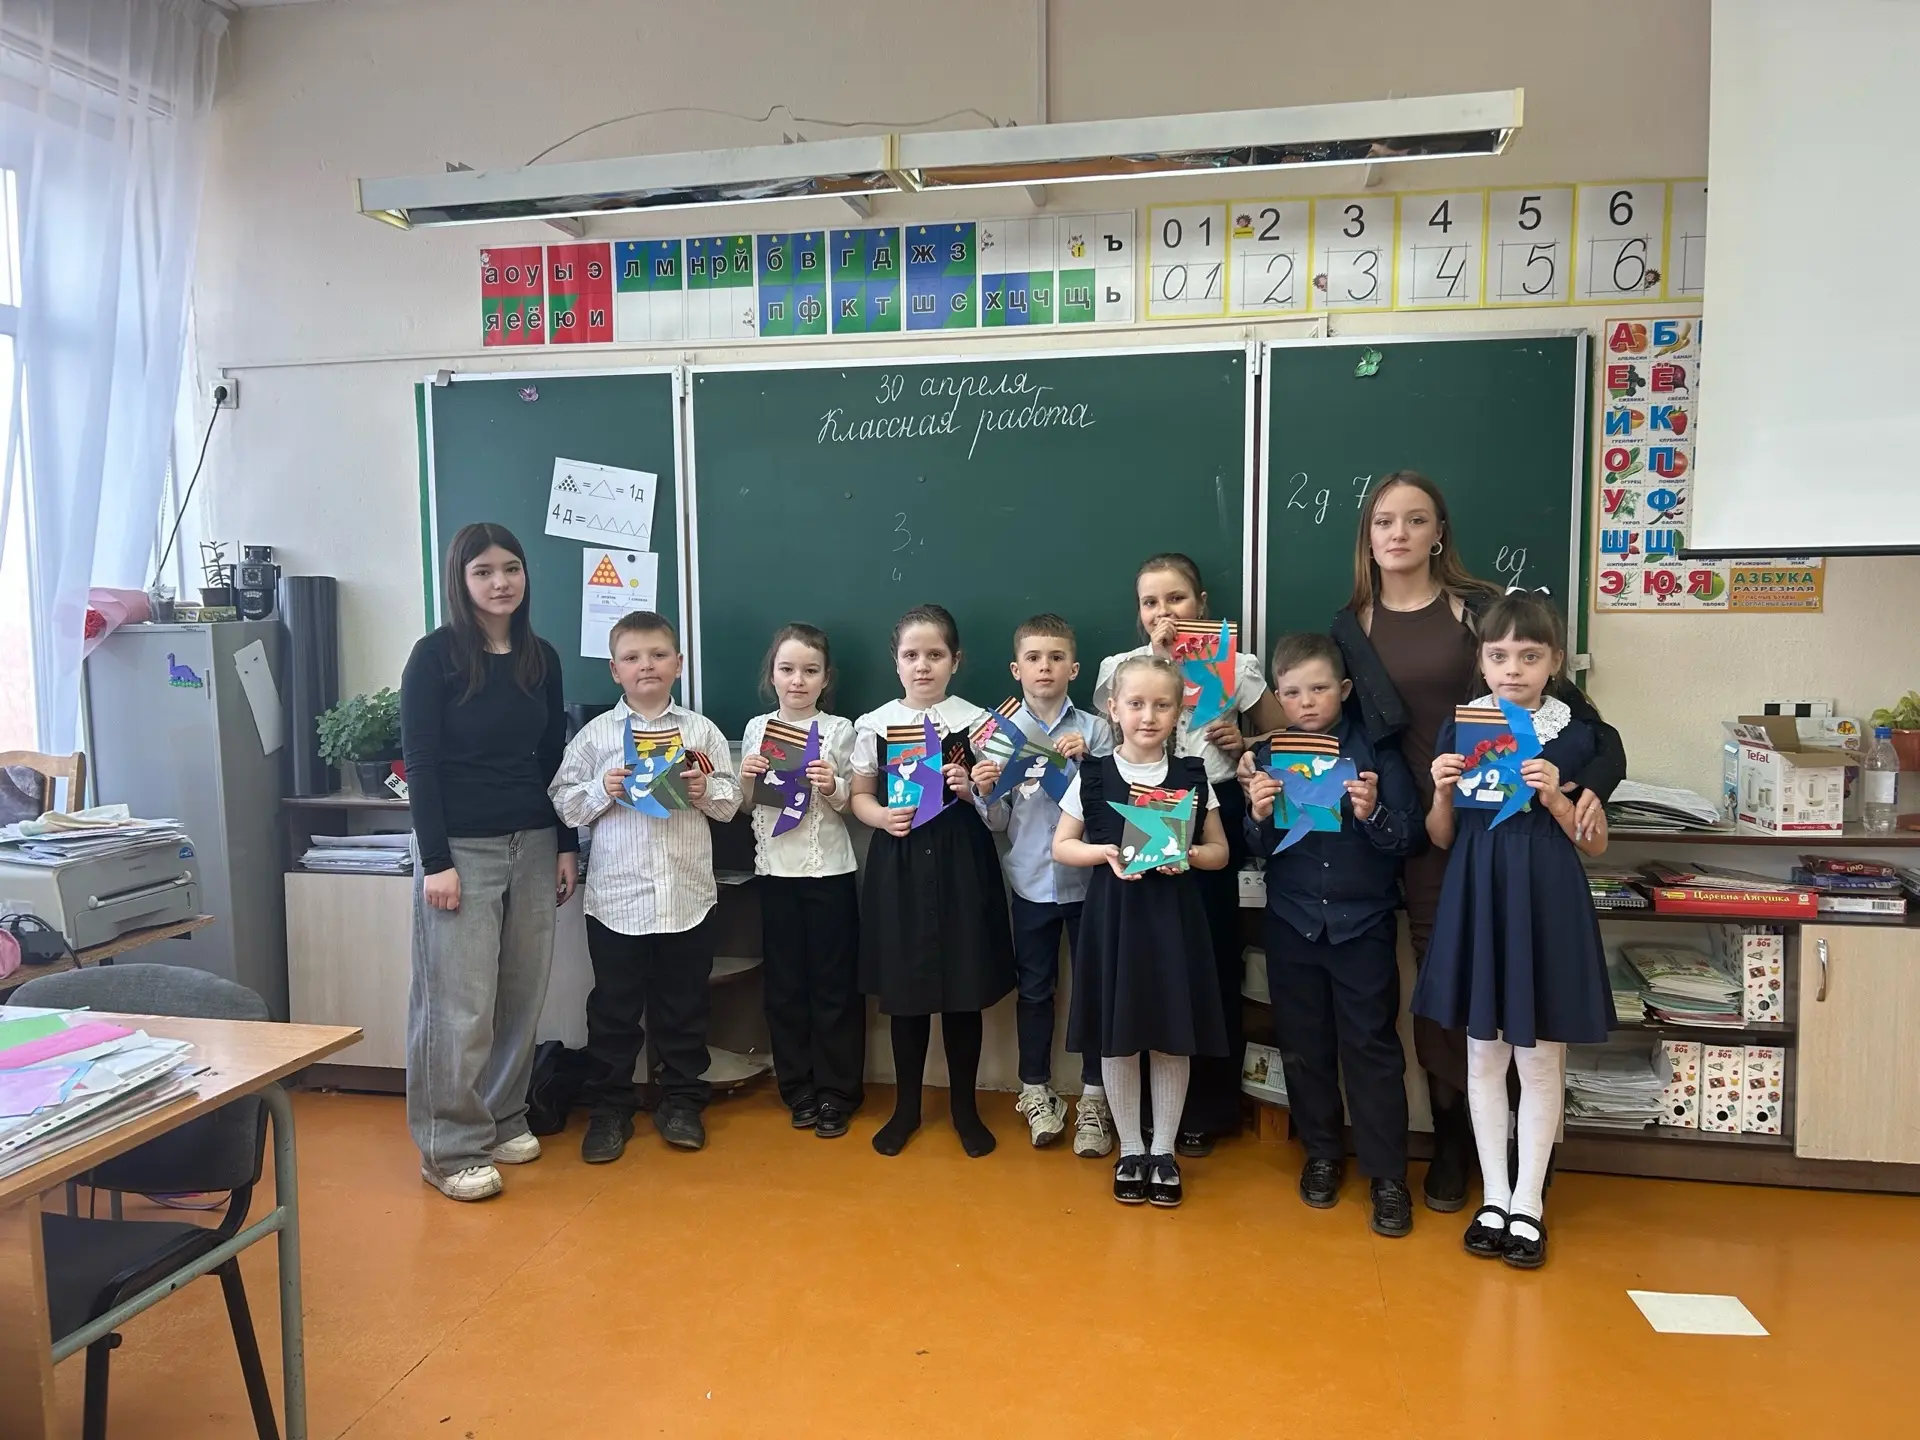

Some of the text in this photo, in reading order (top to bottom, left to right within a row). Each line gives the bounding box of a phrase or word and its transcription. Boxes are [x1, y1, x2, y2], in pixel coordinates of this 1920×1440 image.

[1164, 191, 1634, 248] 0 1 2 3 4 5 6
[1163, 238, 1647, 303] 0 1 2 3 4 5 6
[1609, 321, 1679, 348] А Б
[1607, 362, 1674, 392] Е Ё
[876, 373, 1037, 416] 30 апреля
[818, 386, 1096, 460] Классная работа
[1606, 405, 1674, 435] Й К
[1604, 447, 1675, 472] О П
[1603, 488, 1677, 513] У Ф
[1601, 530, 1675, 556] Ш Щ
[1599, 570, 1713, 595] Э Ю Я
[1734, 572, 1813, 583] АЗБУКА
[1746, 749, 1770, 763] Tefal
[1485, 769, 1500, 789] 9
[1846, 863, 1864, 872] UNO
